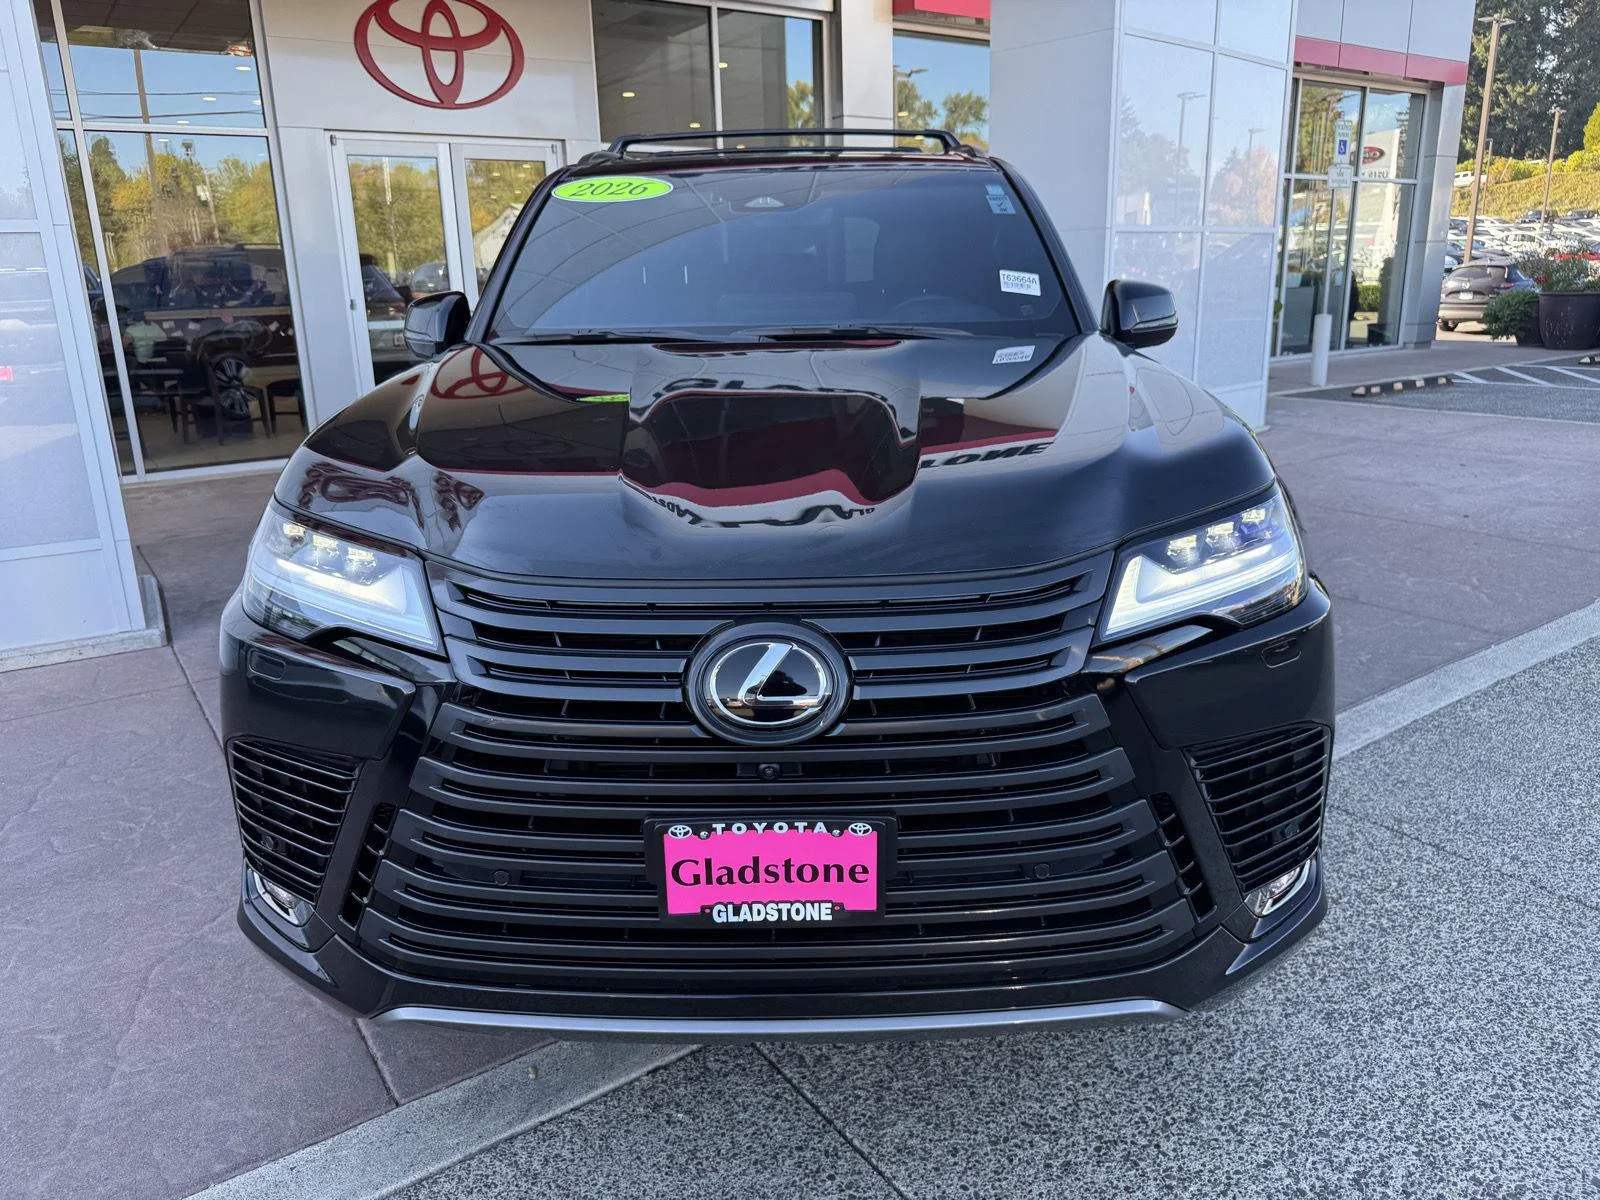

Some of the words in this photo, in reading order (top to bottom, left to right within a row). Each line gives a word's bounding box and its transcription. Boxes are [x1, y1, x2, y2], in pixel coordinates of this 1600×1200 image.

[568, 182, 654, 197] 2026
[1001, 273, 1038, 286] T63664A
[712, 822, 828, 835] TOYOTA
[671, 855, 870, 887] Gladstone
[712, 902, 833, 923] GLADSTONE
